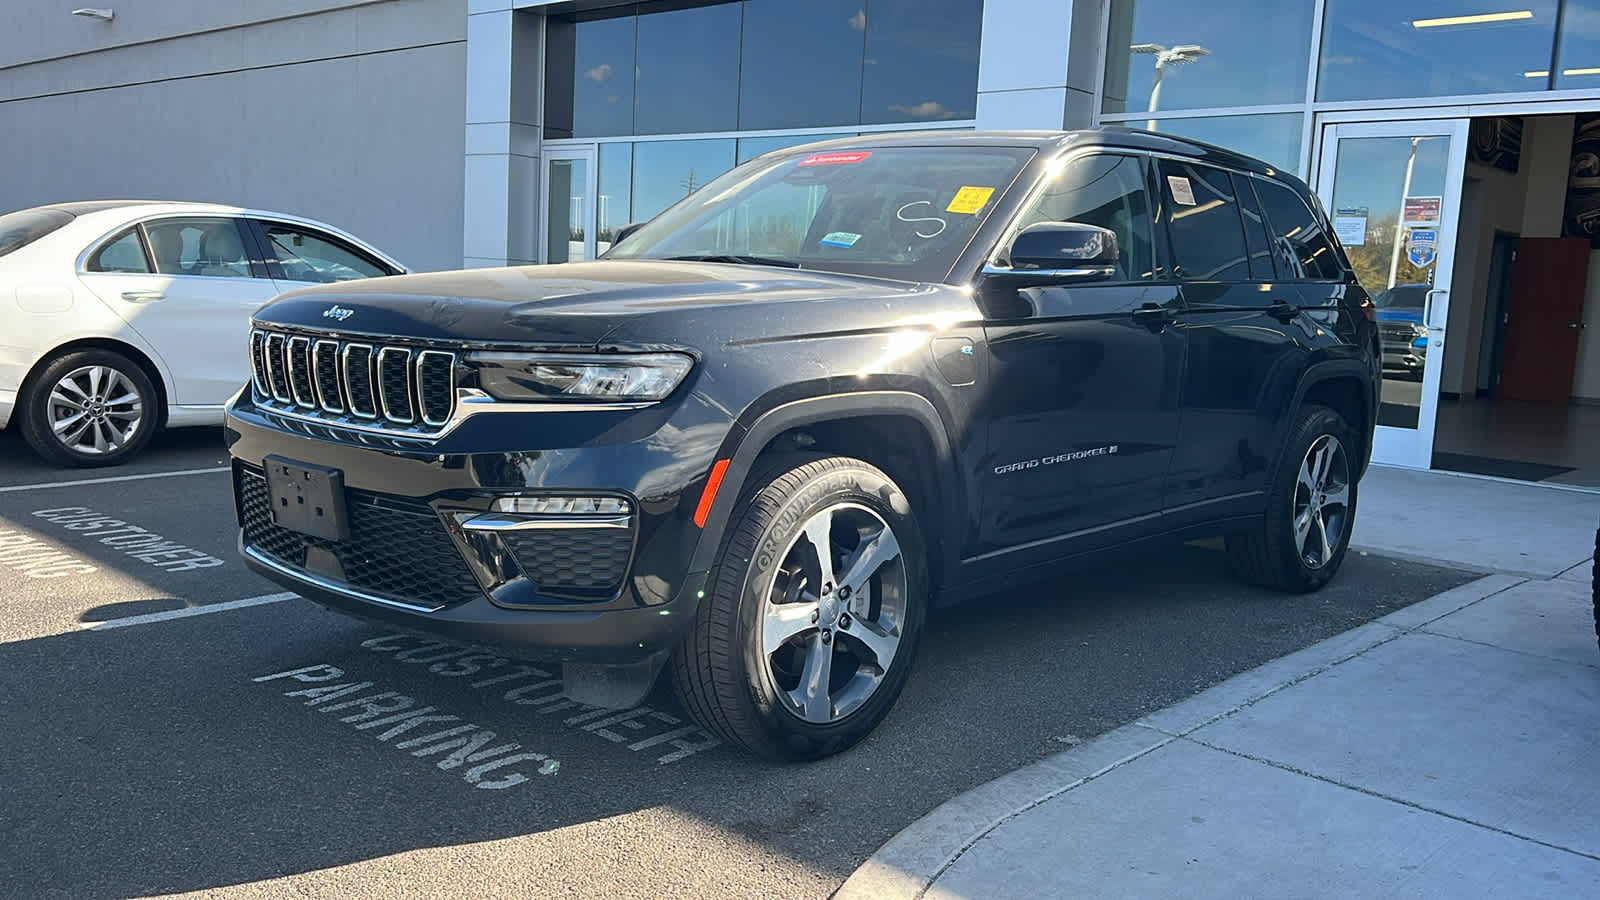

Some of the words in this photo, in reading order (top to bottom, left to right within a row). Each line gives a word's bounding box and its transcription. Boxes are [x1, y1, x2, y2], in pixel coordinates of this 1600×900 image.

[896, 200, 946, 238] S
[322, 304, 354, 321] Jeep
[994, 459, 1040, 475] GRAND
[1041, 447, 1107, 465] CHEROKEE
[31, 506, 225, 572] CUSTOMER
[253, 663, 561, 790] PARKING
